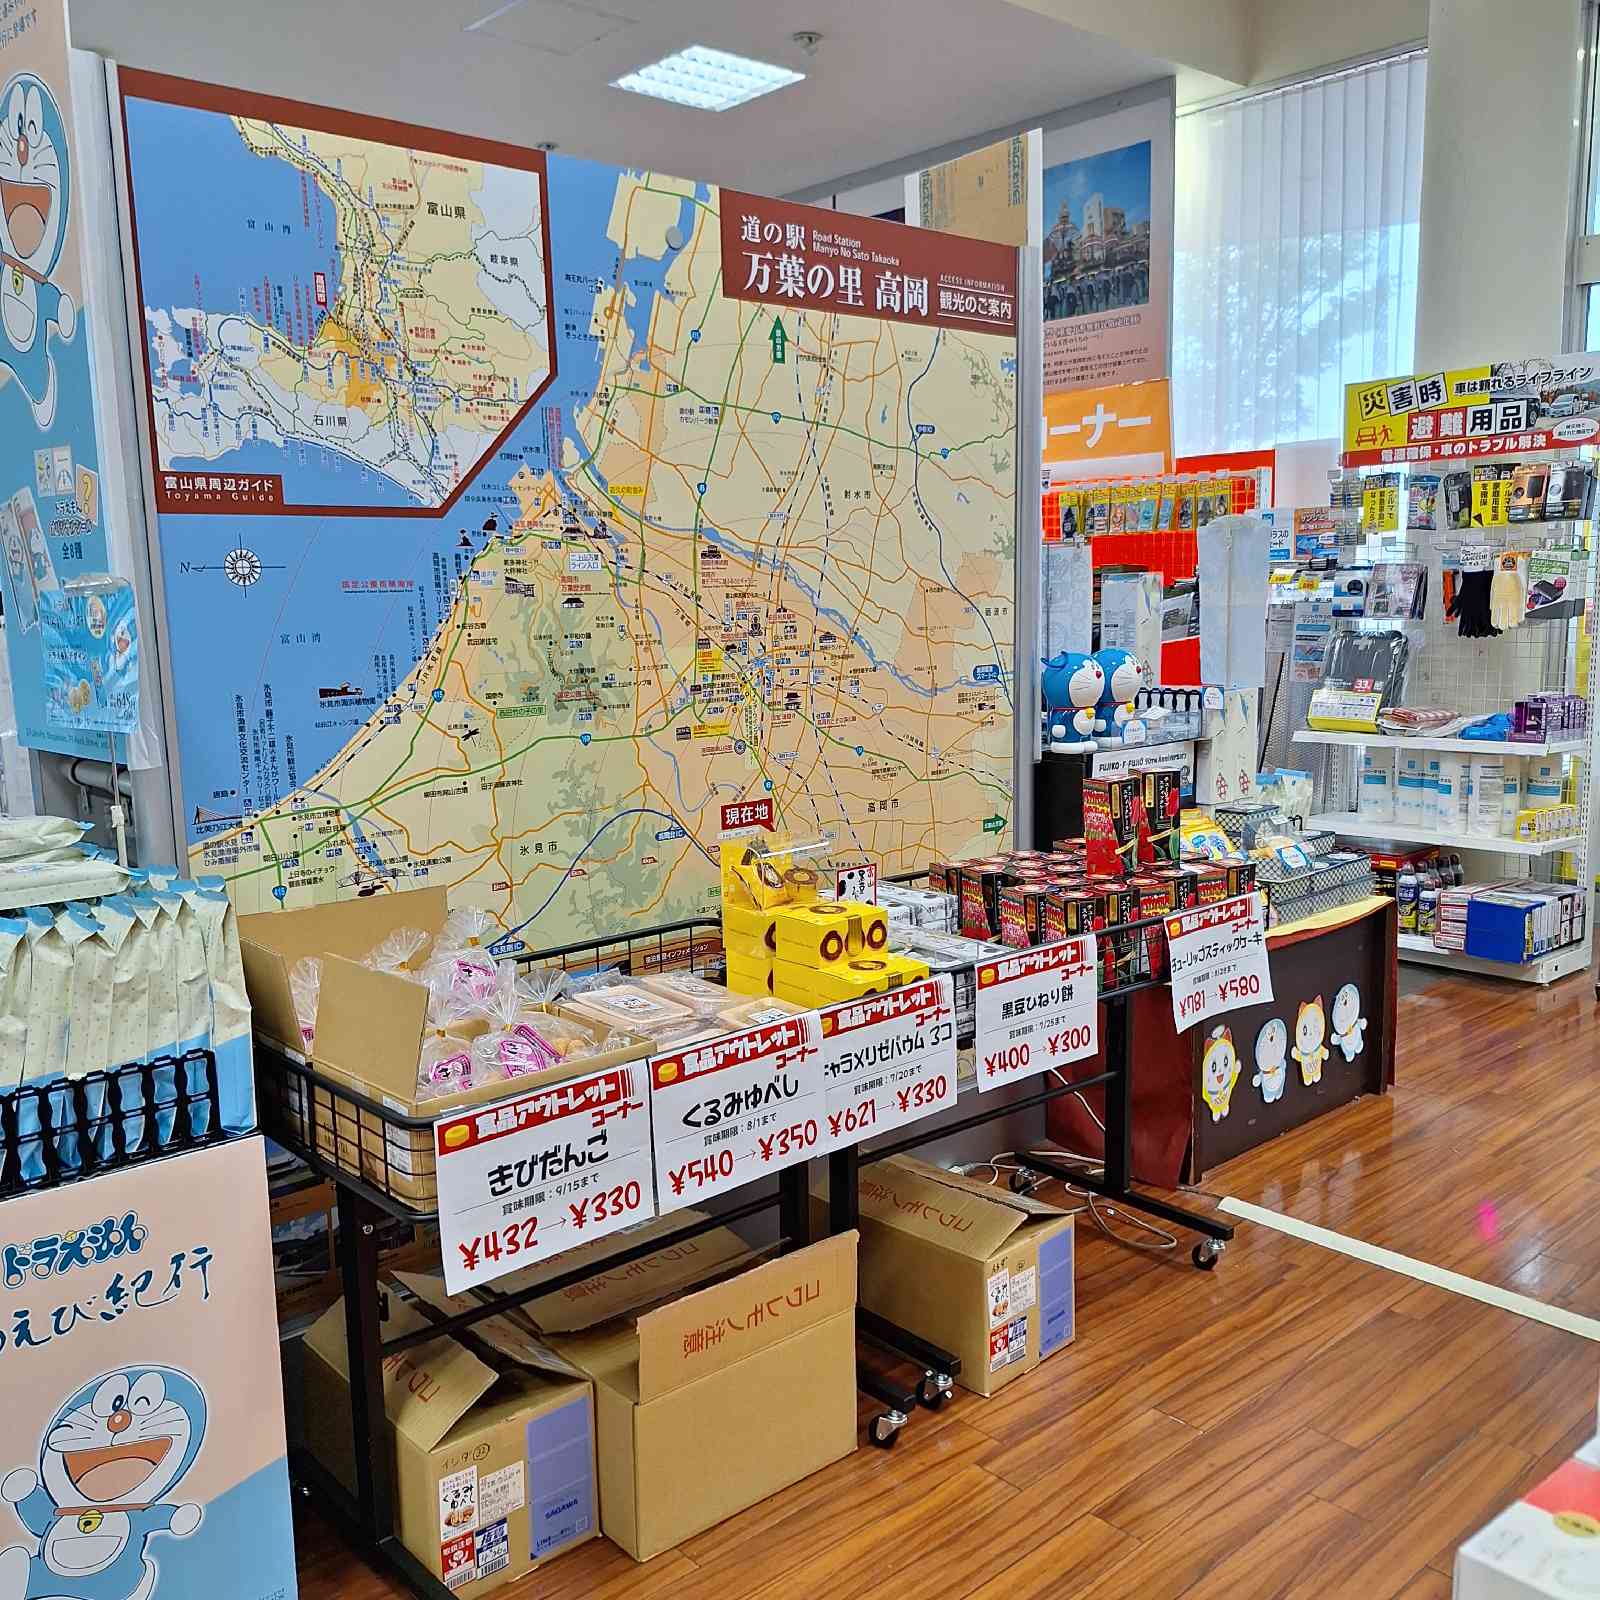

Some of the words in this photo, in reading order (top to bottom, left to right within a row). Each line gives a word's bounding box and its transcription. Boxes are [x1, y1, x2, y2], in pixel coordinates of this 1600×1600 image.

[427, 202, 466, 220] 富山県
[740, 215, 806, 251] 道の駅
[813, 231, 832, 243] Road
[834, 233, 861, 248] Station
[813, 242, 839, 257] Manyo
[841, 244, 851, 257] No
[852, 247, 870, 261] Sato
[871, 250, 900, 266] Takaoka
[743, 251, 865, 307] 万葉の里
[875, 271, 929, 317] 高岡
[939, 290, 1012, 320] 観光のご案内
[1454, 367, 1592, 396] 車は頼れるライフライン
[1362, 381, 1443, 417] 災害時
[314, 414, 348, 427] 石川県
[1041, 403, 1152, 449] ーナー
[1411, 405, 1523, 441] 避難用品
[164, 475, 274, 492] 富山県周辺ガイド
[166, 491, 217, 502] Toyama
[231, 492, 274, 502] Guide
[844, 489, 871, 499] 射水市
[180, 561, 191, 573] N
[725, 804, 769, 826] 現在地
[519, 840, 559, 856] 氷見市
[1232, 919, 1260, 934] コーナー
[1172, 932, 1263, 973] チューリップスティックケーキ
[1061, 963, 1094, 982] コーナー
[1001, 984, 1075, 1020] 黒豆ひねり餅
[1179, 990, 1206, 1020] ¥781
[1219, 974, 1261, 1002] ¥580
[915, 1007, 952, 1027] コーナー
[775, 1046, 819, 1070] コーナー
[824, 1031, 925, 1080] ャラメリゼバウム
[984, 1043, 1030, 1077] ¥400
[1047, 1024, 1092, 1056] ¥300
[591, 1101, 645, 1128] コーナー
[682, 1074, 800, 1128] くるみゆべし
[827, 1099, 877, 1138] ¥621
[896, 1075, 948, 1113] ¥330
[488, 1129, 609, 1197] きびだんご
[668, 1150, 735, 1196] ¥540
[758, 1119, 818, 1162] ¥350
[459, 1216, 539, 1272] ¥432
[569, 1180, 642, 1230] ¥330
[2, 1210, 149, 1289] ドラえもん
[683, 1280, 820, 1359] コワレモノ注意
